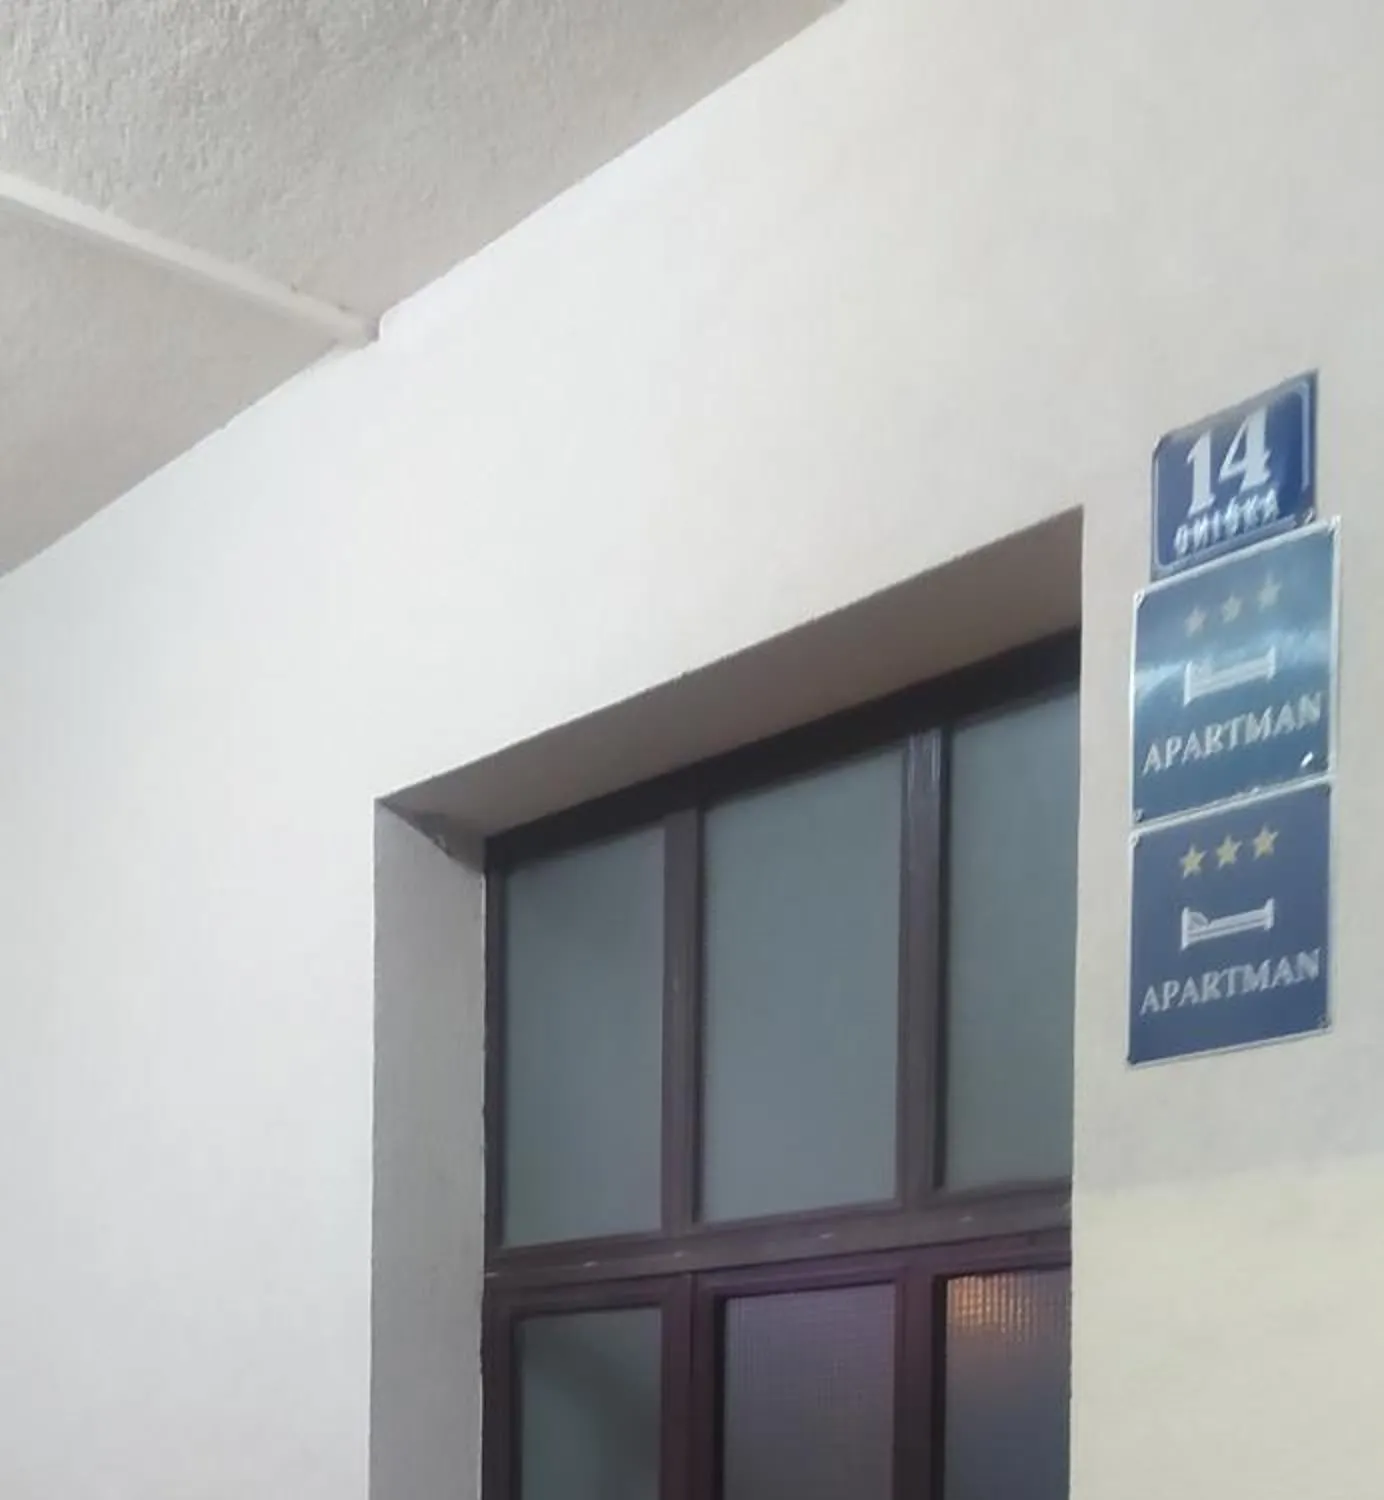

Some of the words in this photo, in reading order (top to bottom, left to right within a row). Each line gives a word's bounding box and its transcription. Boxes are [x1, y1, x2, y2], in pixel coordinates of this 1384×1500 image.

[1187, 406, 1271, 518] 14
[1142, 691, 1323, 776] APARTMAN
[1140, 947, 1321, 1015] APARTMAN
